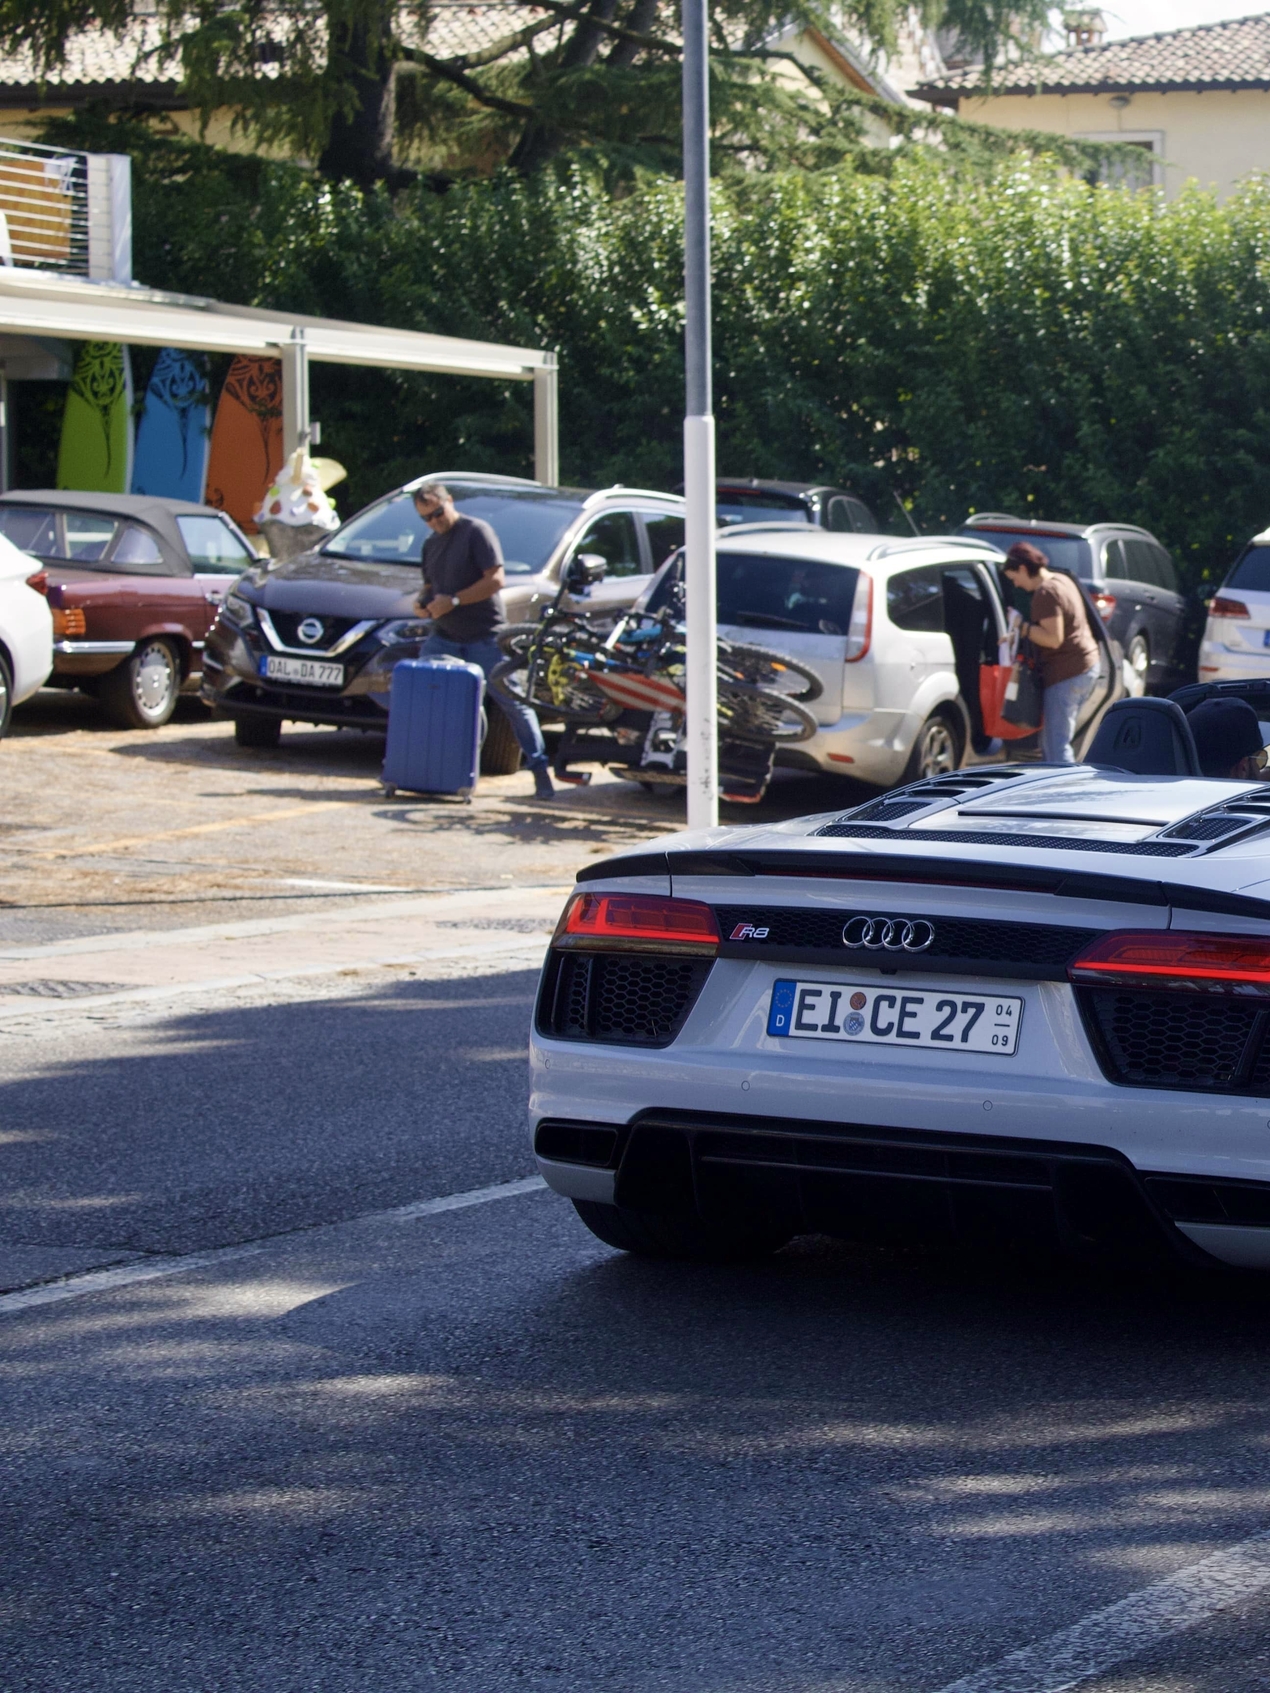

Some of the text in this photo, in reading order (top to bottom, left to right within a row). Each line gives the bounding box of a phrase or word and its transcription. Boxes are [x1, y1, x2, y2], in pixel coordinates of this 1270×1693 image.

[268, 660, 342, 681] OAL DA 777
[735, 925, 770, 939] R8
[794, 988, 986, 1043] EI CE 27
[995, 1004, 1013, 1016] 04
[775, 1015, 785, 1027] D
[991, 1034, 1009, 1047] 09
